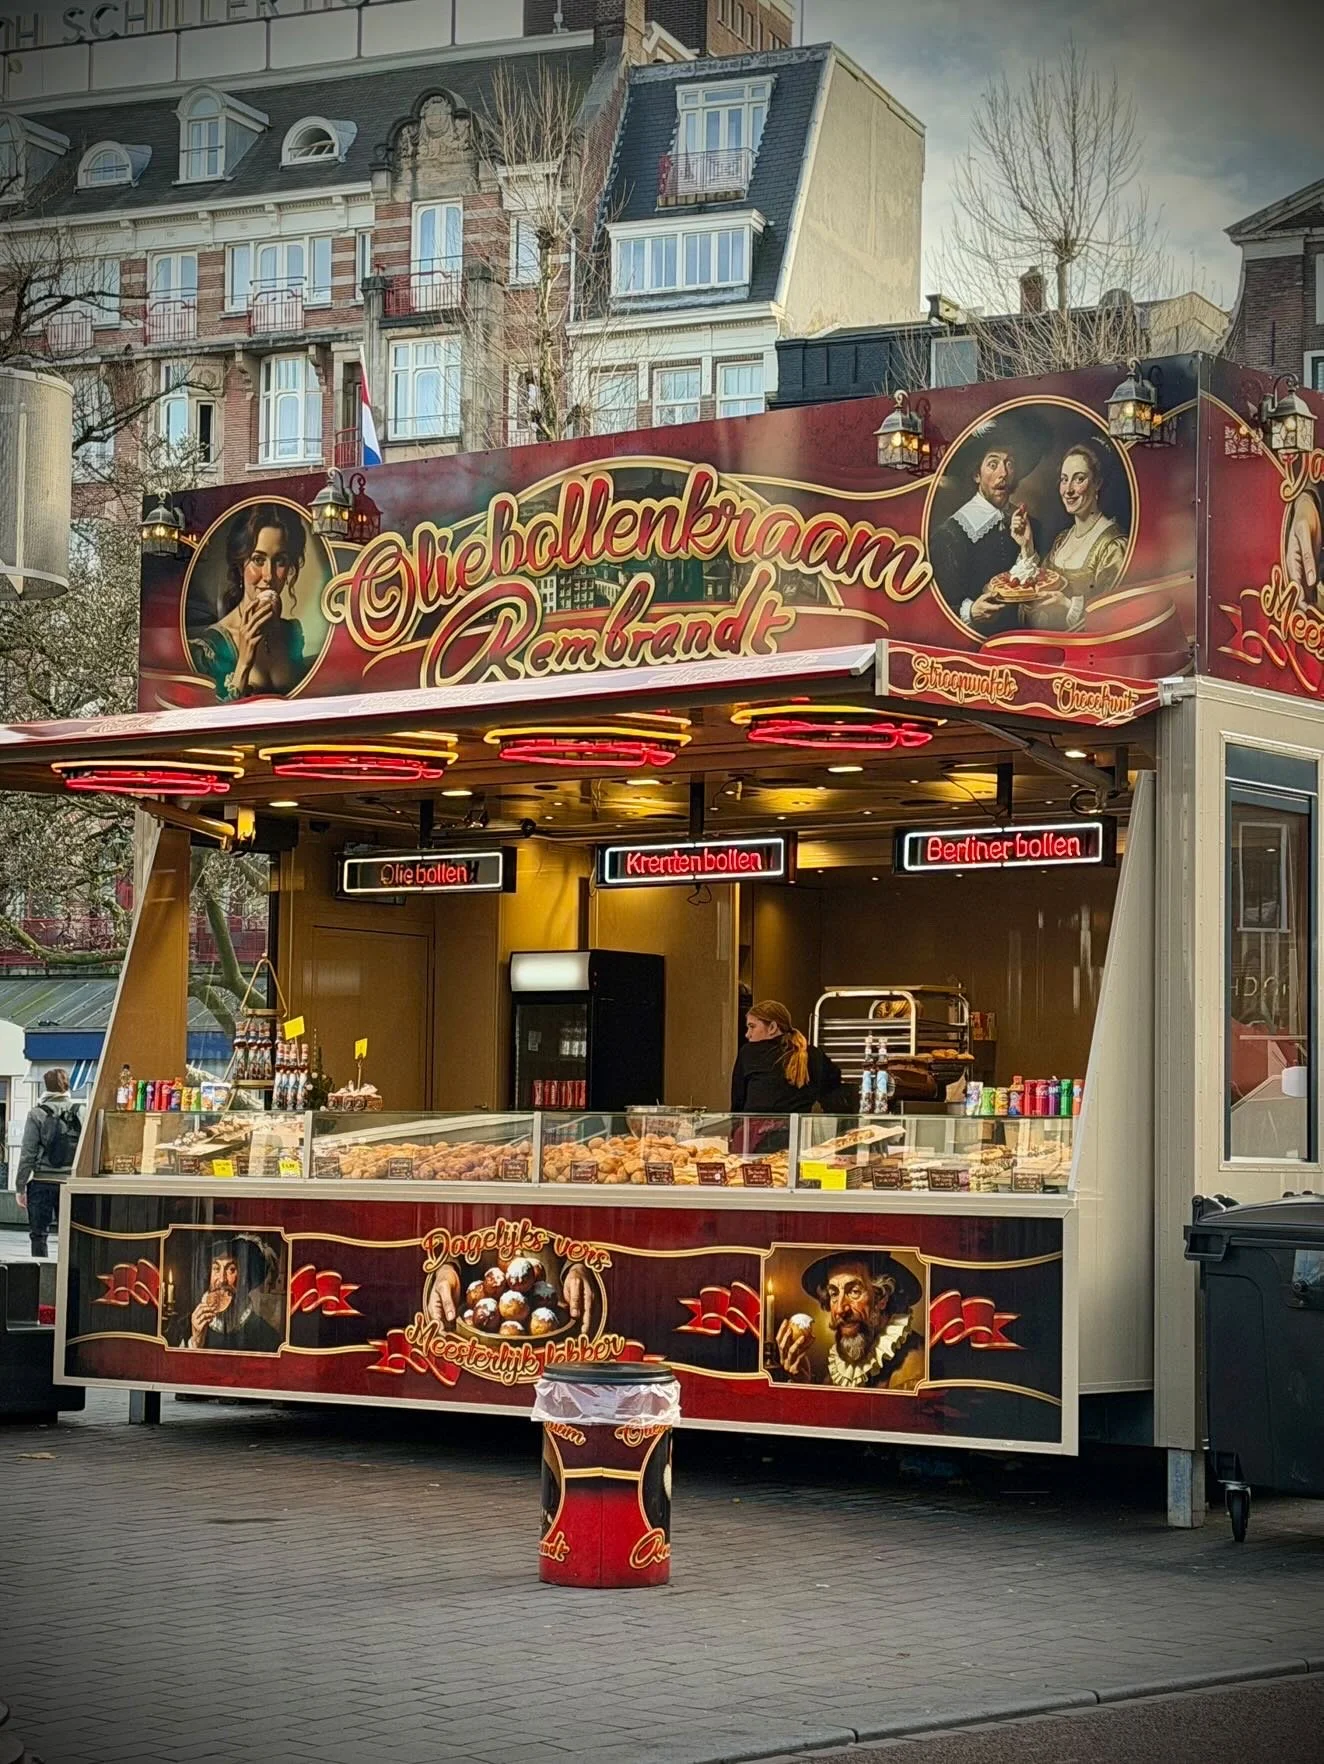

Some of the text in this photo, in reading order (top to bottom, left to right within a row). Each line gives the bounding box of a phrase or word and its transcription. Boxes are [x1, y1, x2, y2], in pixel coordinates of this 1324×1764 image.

[321, 463, 933, 652] Oliebollenkraam
[419, 561, 797, 690] Rembrandt
[911, 652, 1019, 705] Stroopwafels
[421, 1217, 613, 1273] Dagelijks vers
[404, 1312, 540, 1386] Meesterlijk
